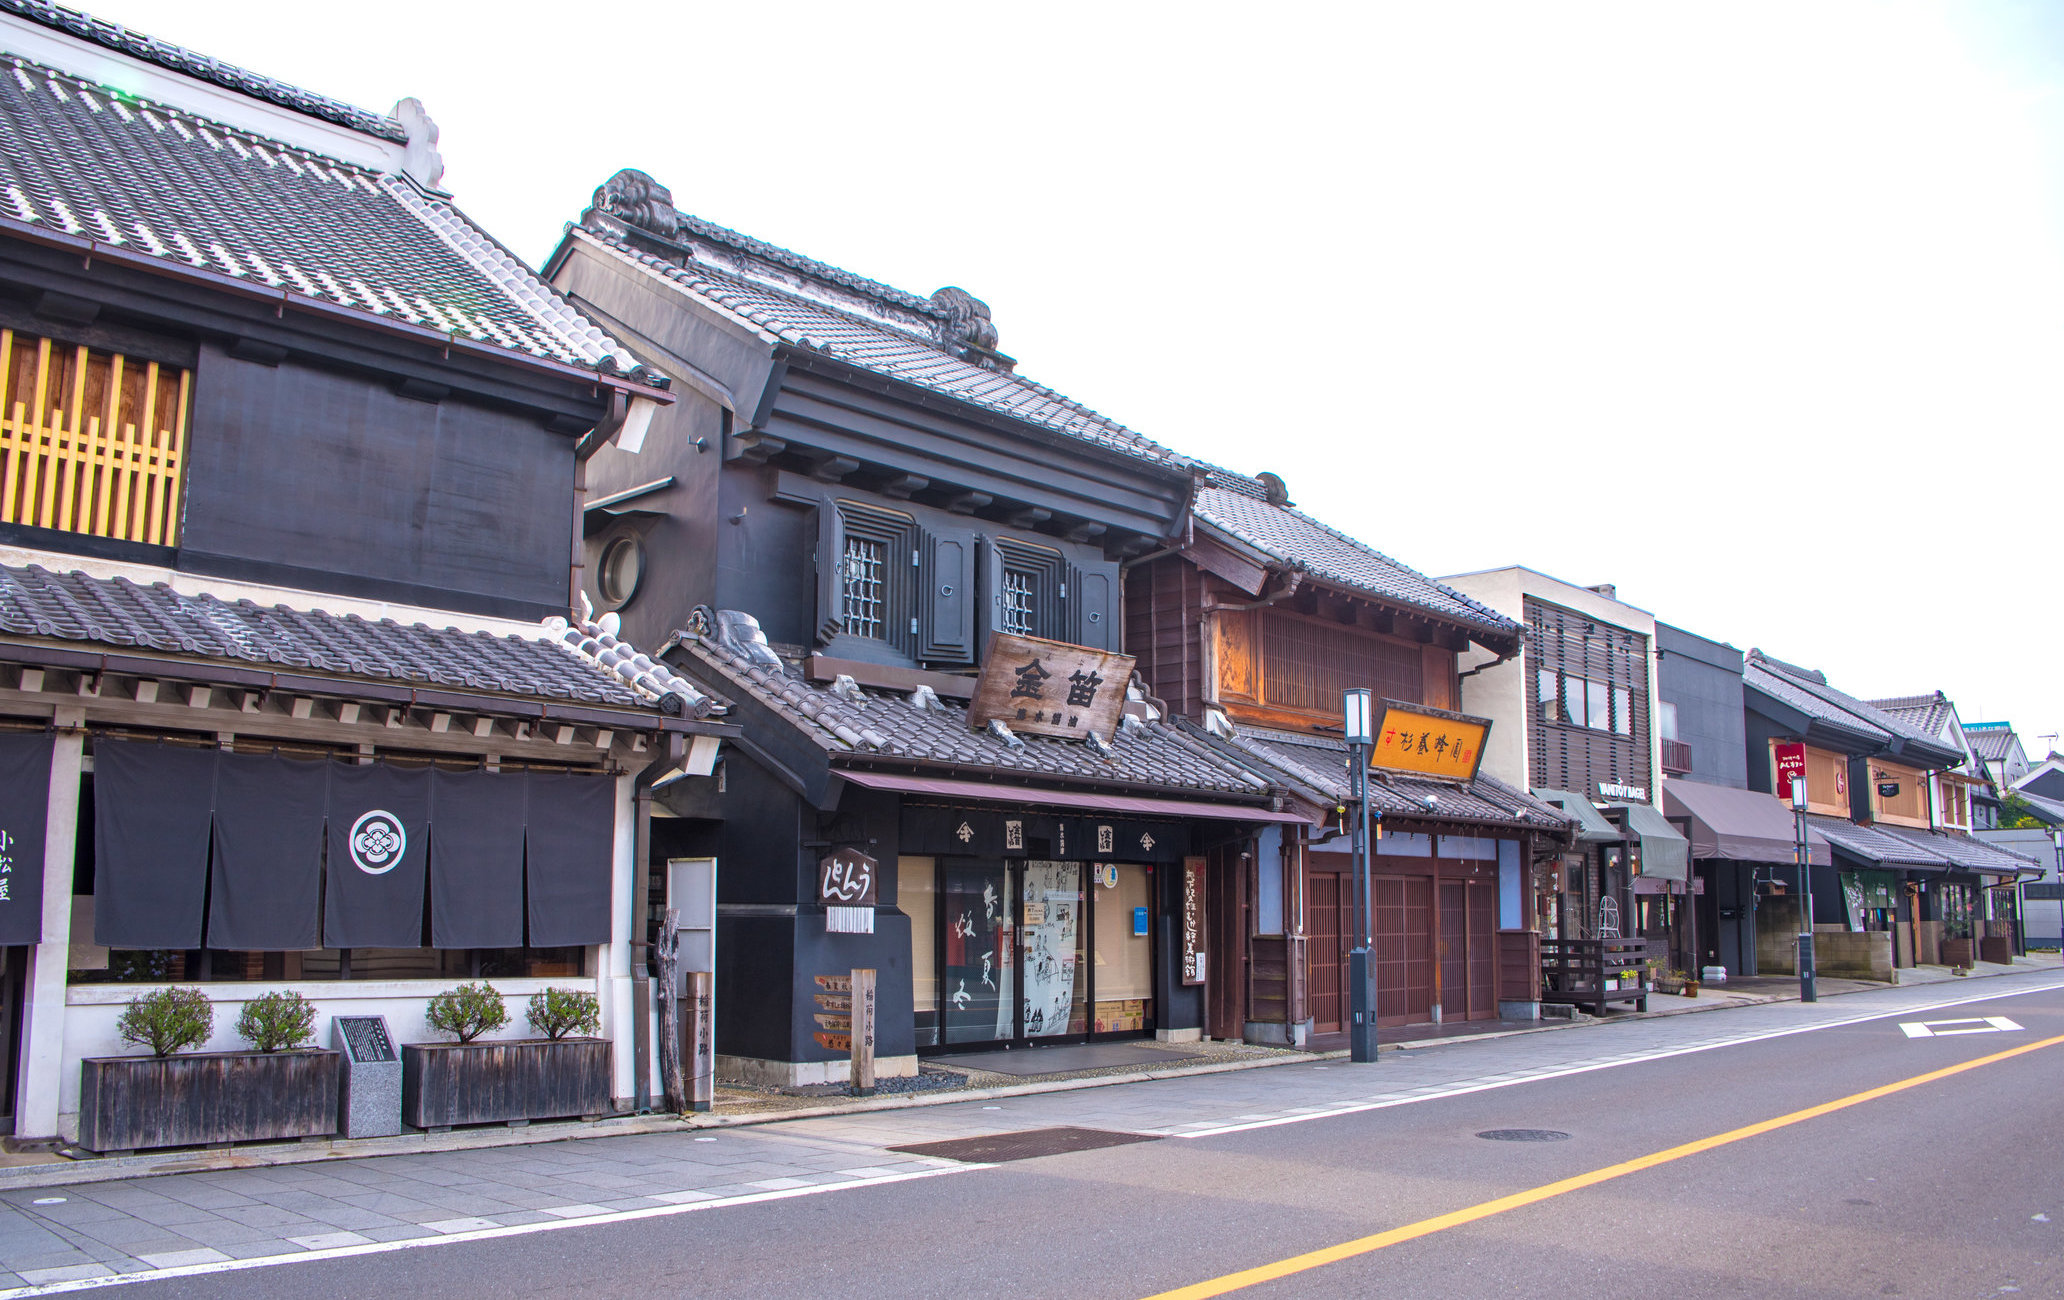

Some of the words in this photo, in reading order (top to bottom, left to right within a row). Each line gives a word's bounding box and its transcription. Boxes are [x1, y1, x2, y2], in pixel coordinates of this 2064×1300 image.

[1010, 657, 1104, 708] 金笛
[1400, 731, 1463, 763] 杉養蜂園
[698, 994, 709, 1056] 稲荷小路
[864, 989, 874, 1047] 稲荷小路
